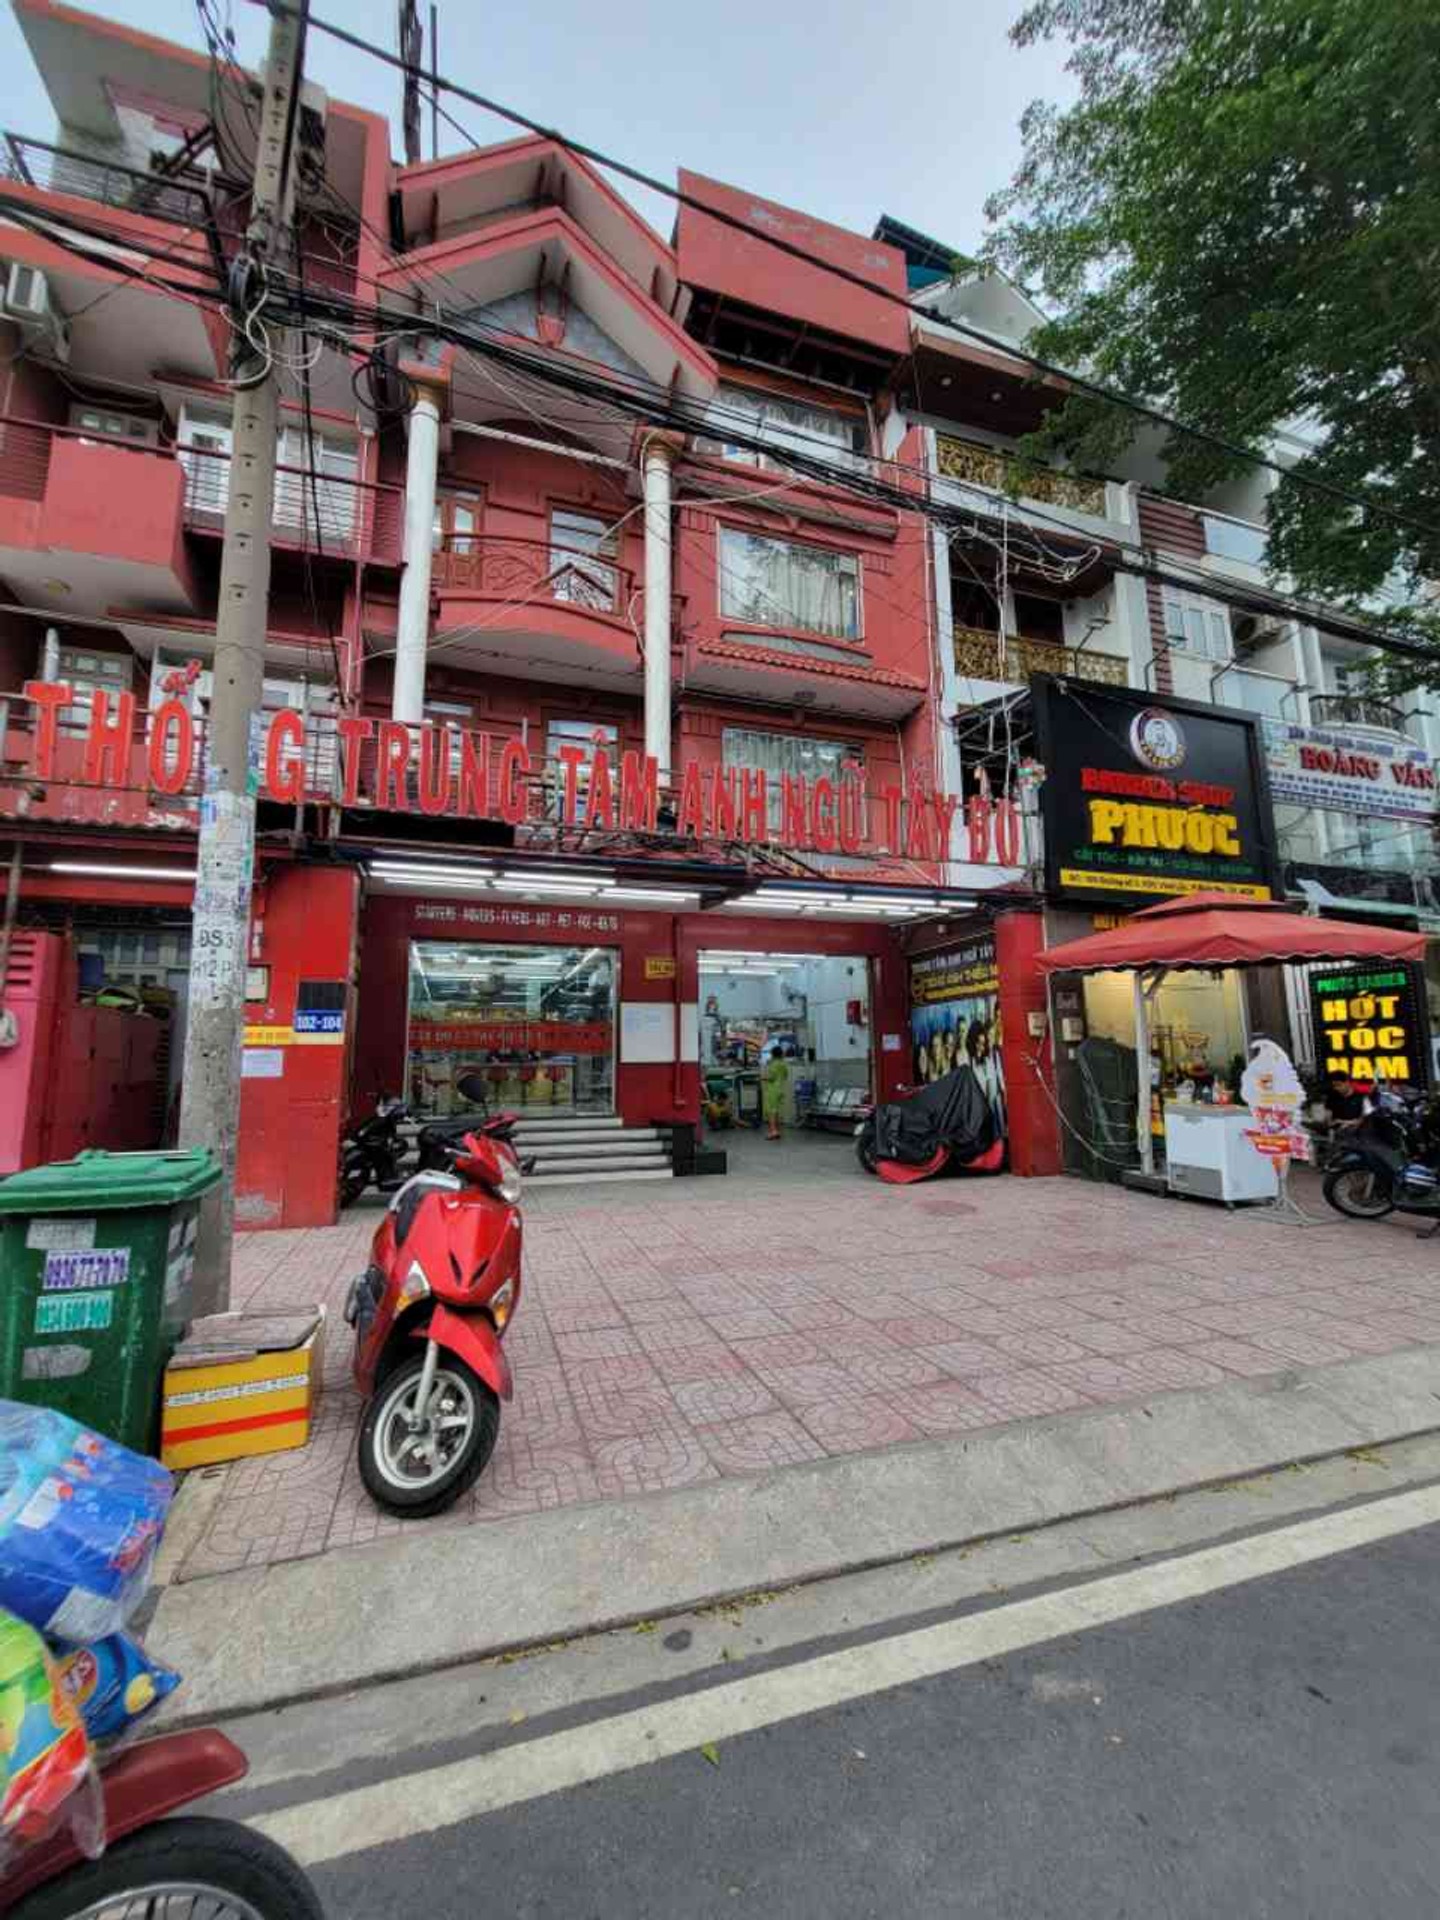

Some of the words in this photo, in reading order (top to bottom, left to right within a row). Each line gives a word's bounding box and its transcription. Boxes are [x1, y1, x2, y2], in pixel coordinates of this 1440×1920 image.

[25, 660, 304, 802] THỐG
[337, 718, 531, 824] TRUNG
[554, 727, 659, 834] TÂM
[677, 760, 766, 840] ANH
[1089, 799, 1241, 857] PHƯỚC
[1322, 989, 1400, 1022] HỚT
[1326, 1021, 1406, 1052] TÓC
